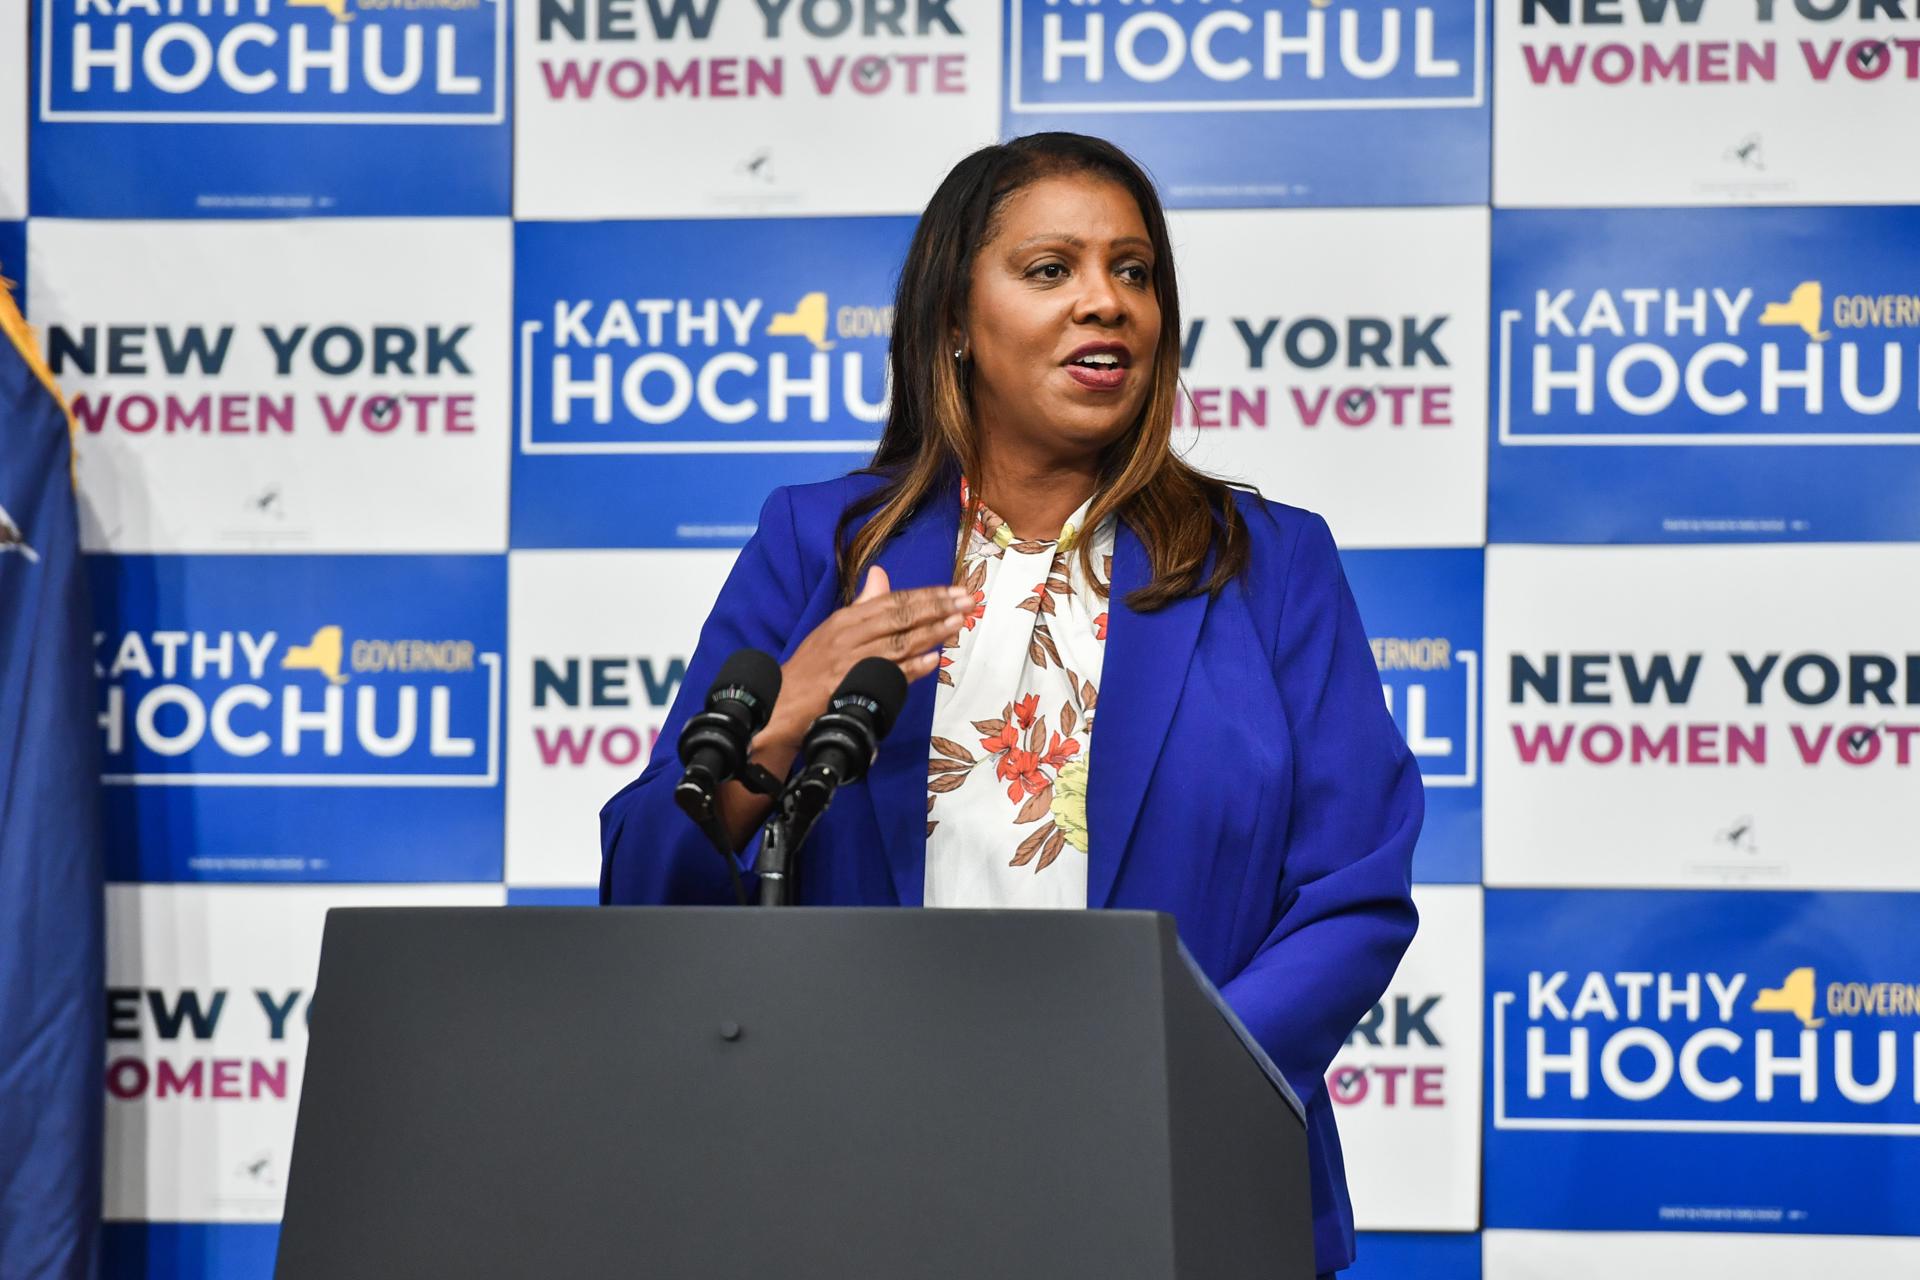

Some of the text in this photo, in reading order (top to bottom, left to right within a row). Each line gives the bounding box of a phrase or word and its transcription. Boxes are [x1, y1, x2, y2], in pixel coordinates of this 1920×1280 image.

[537, 0, 965, 41] NEW YORK
[1042, 8, 1460, 83] HOCHUL
[73, 22, 482, 94] HOCHUL
[539, 54, 967, 100] WOMEN VOTE
[1520, 38, 1920, 85] WOMEN VOT
[553, 298, 763, 348] KATHY
[1534, 287, 1753, 338] KATHY
[46, 324, 474, 376] NEW YORK
[1232, 315, 1452, 370] YORK
[552, 351, 893, 424] HOCHU
[1532, 341, 1920, 416] HOCHU
[70, 393, 476, 435] WOMEN VOTE
[1290, 385, 1454, 428] VOTE
[351, 638, 475, 674] GOVERNOR
[532, 656, 690, 707] NEW
[1509, 652, 1920, 706] NEW YOR
[532, 725, 660, 766] WO
[1510, 722, 1920, 767] WOMEN VOT
[1527, 970, 1748, 1022] KATHY
[1526, 1026, 1920, 1105] HOCHU
